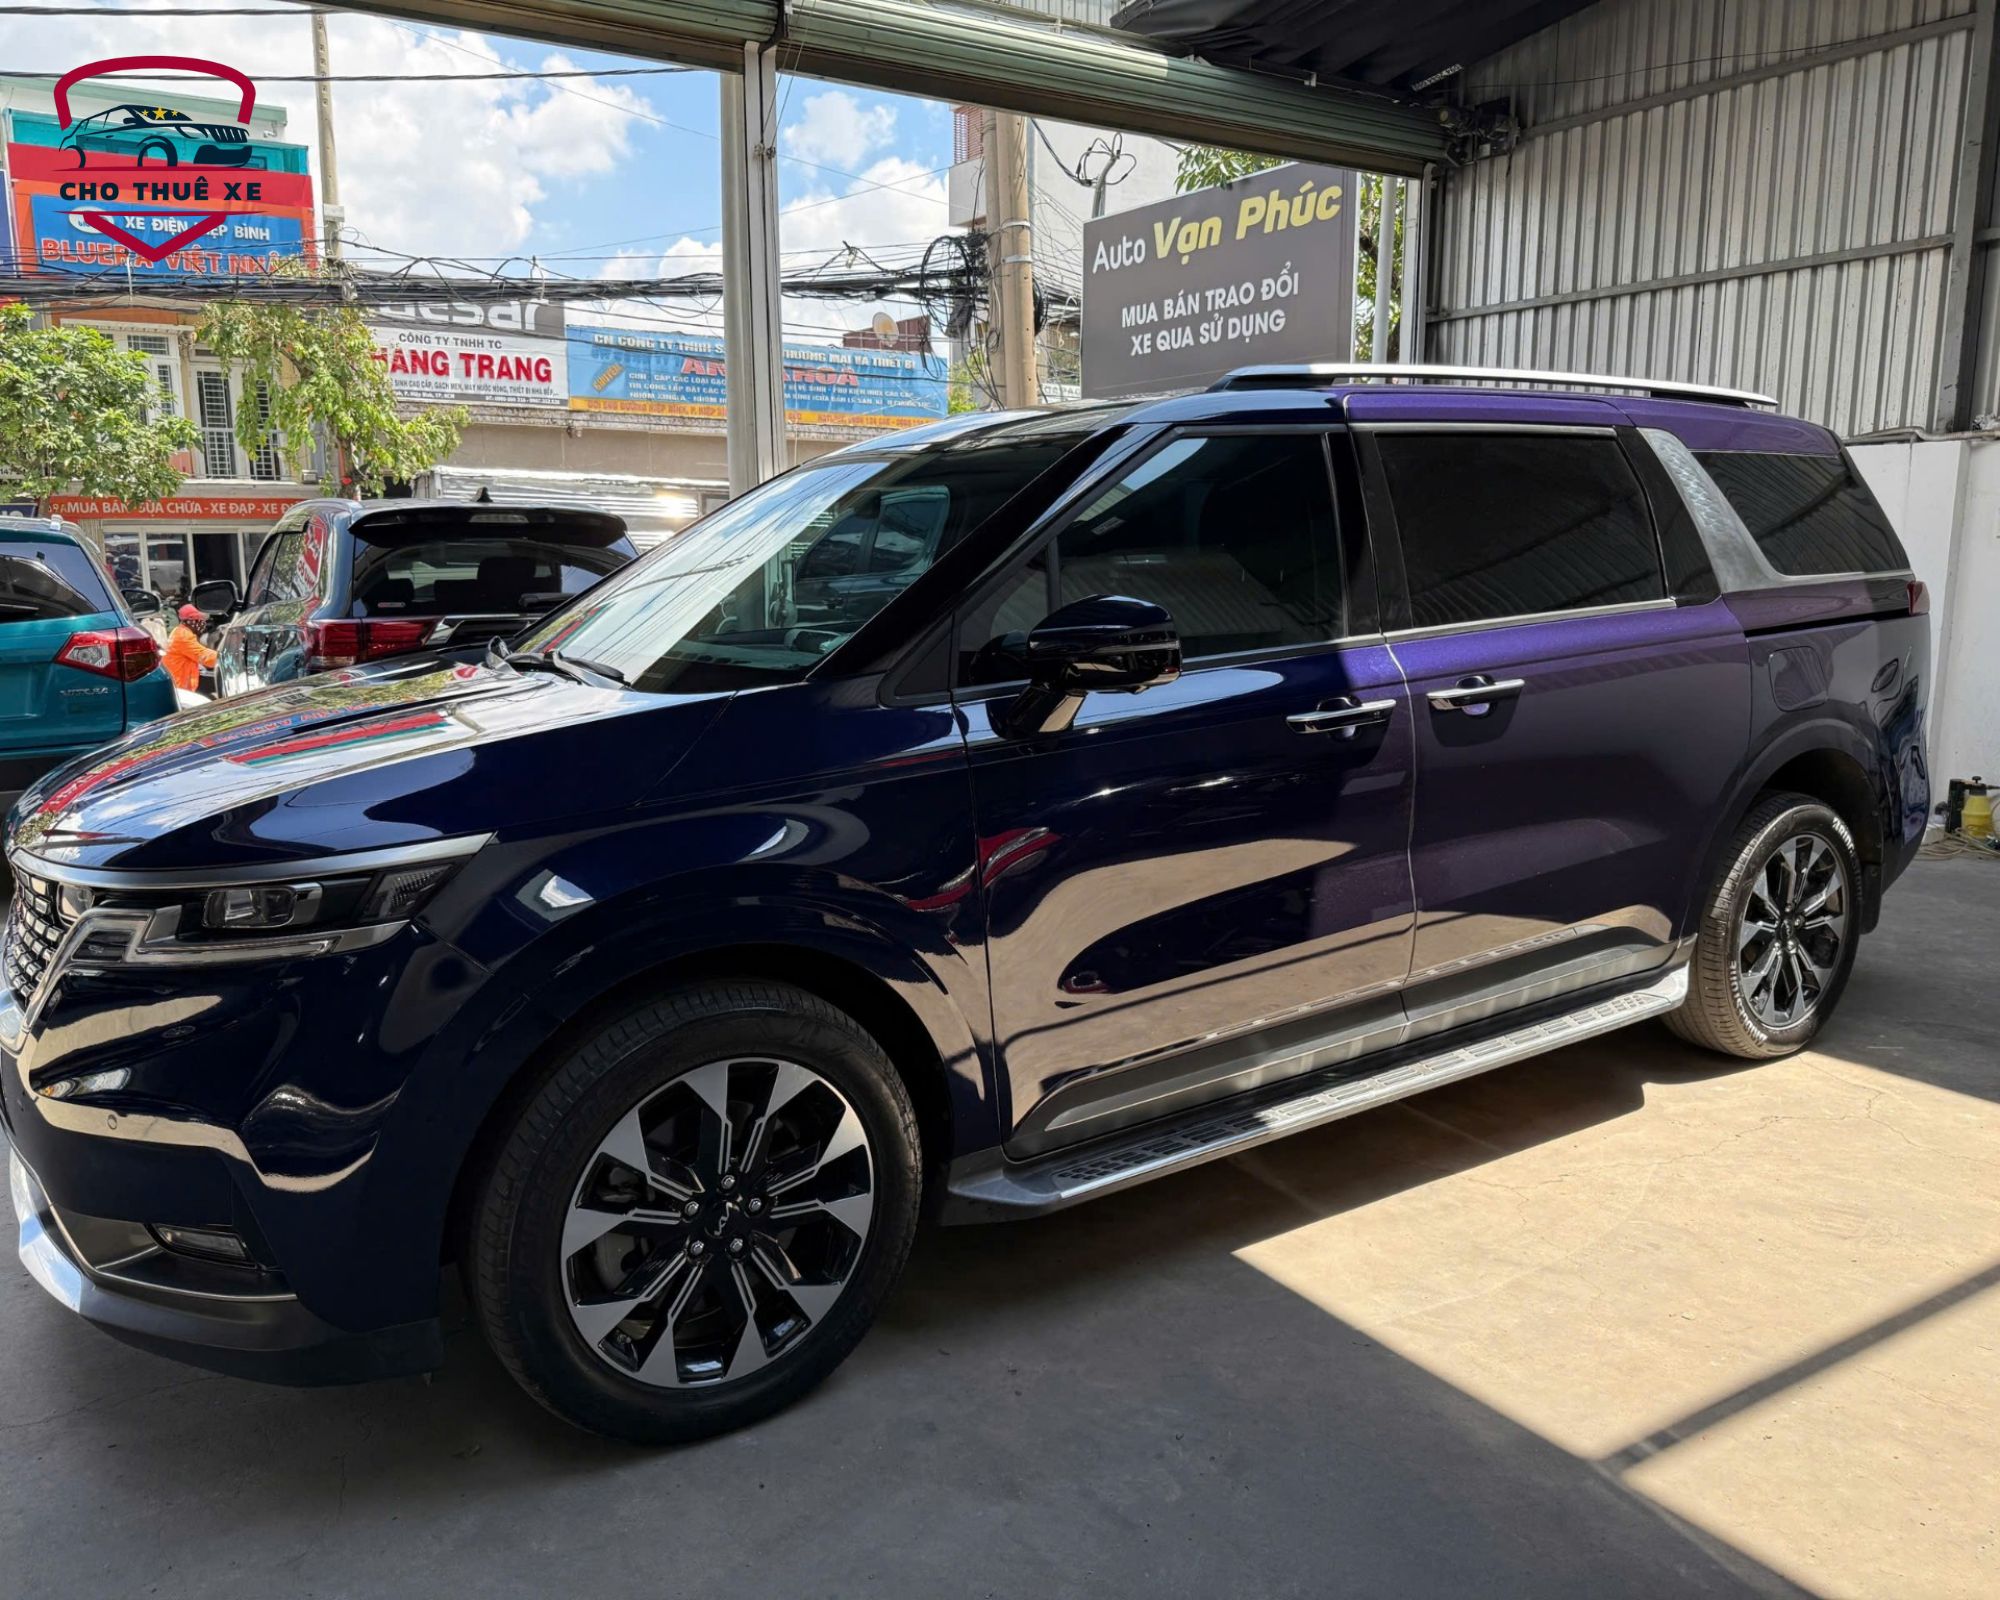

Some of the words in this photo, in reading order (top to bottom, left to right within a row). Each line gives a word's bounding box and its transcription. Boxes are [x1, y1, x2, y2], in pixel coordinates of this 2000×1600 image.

[125, 216, 145, 230] XE
[151, 217, 188, 236] ĐIỆN
[234, 223, 271, 240] BÌNH
[1093, 235, 1146, 275] Auto
[1153, 216, 1222, 265] Vạn
[1235, 180, 1343, 240] Phúc
[1121, 302, 1158, 328] MUA
[1163, 289, 1200, 320] BÁN
[1205, 282, 1255, 312] TRAO
[1260, 261, 1299, 301] ĐỔI
[399, 330, 432, 344] CÔNG
[435, 336, 450, 346] TY
[452, 337, 485, 349] TNHH
[488, 340, 503, 350] TC
[1130, 333, 1152, 356] XE
[1156, 326, 1195, 352] QUA
[1199, 313, 1224, 345] SỬ
[1228, 309, 1286, 343] DỤNG
[369, 347, 450, 377] HANG
[458, 352, 552, 383] TRANG
[67, 501, 100, 514] MUA
[166, 499, 203, 514] CHỮA
[210, 502, 226, 514] XE
[229, 502, 257, 517] ĐẠP
[262, 502, 278, 514] XE
